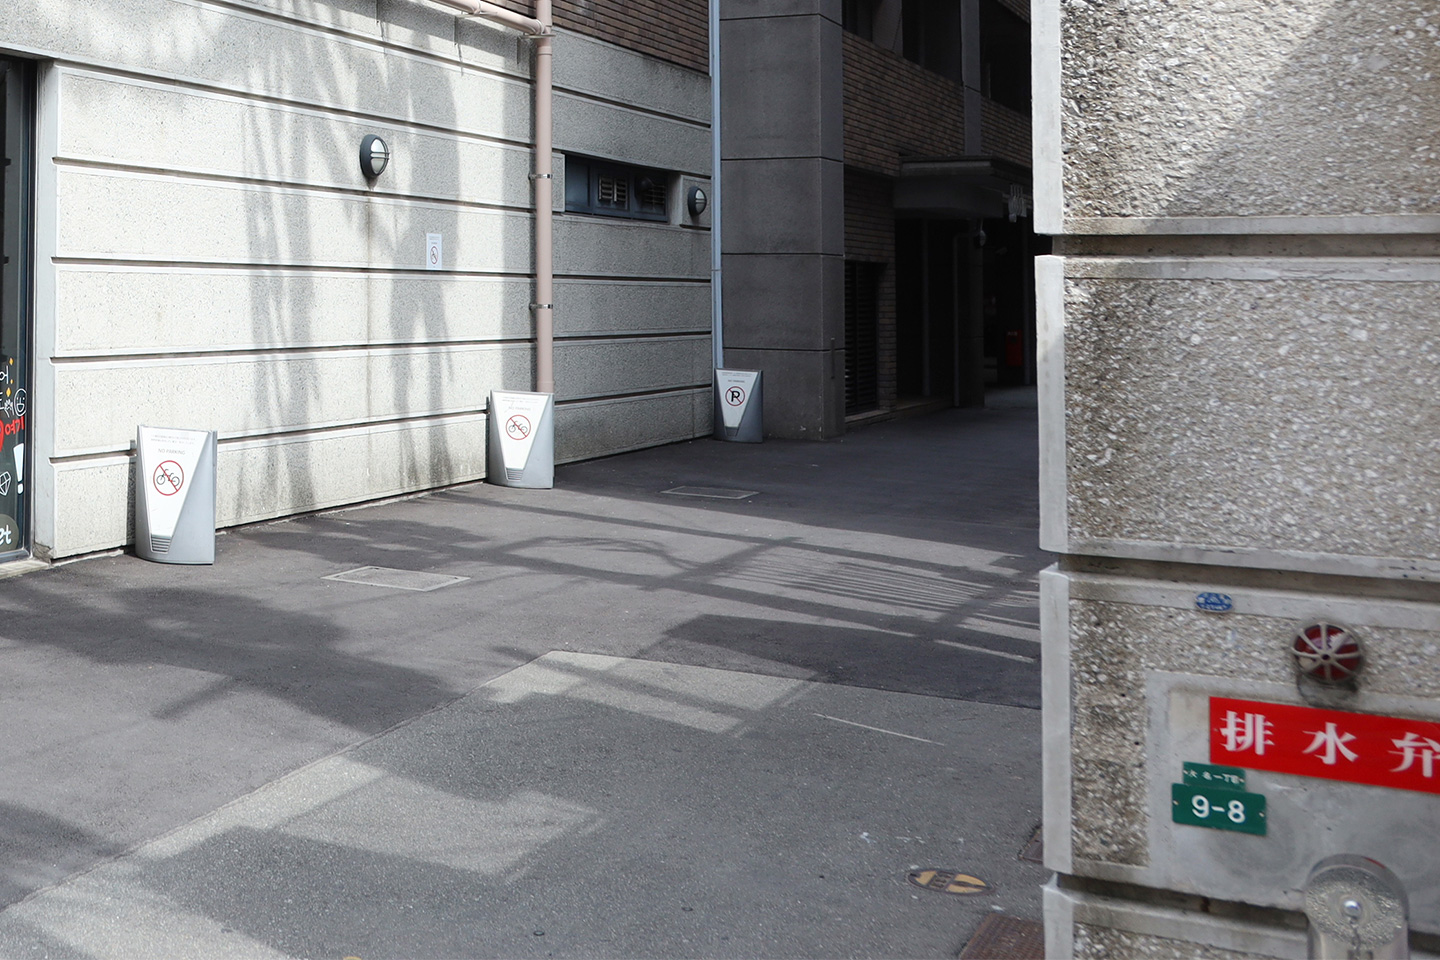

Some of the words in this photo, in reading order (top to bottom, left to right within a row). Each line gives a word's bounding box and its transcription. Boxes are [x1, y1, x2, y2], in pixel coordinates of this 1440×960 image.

[1219, 710, 1440, 778] 排水弁
[1191, 794, 1246, 824] 9-8
